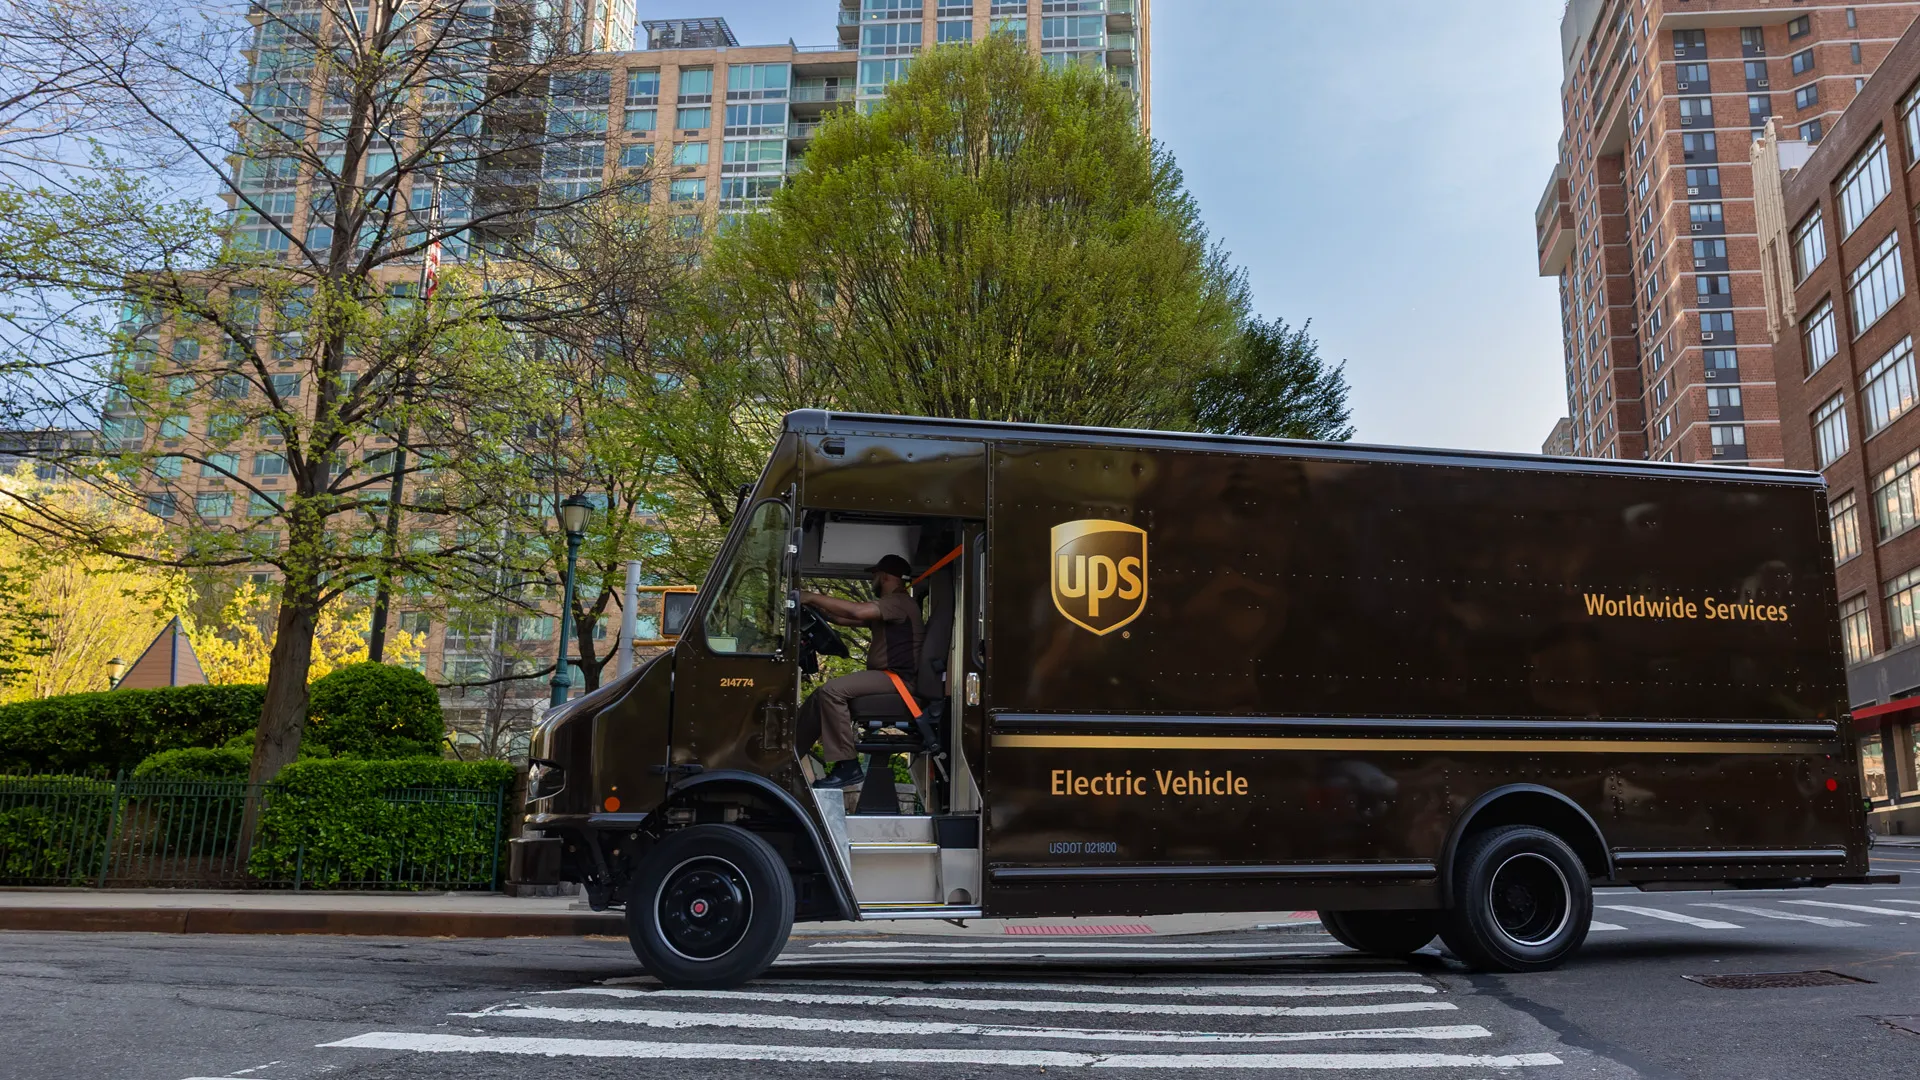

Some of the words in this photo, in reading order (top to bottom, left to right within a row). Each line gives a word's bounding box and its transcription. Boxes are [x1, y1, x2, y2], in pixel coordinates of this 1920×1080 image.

[1058, 554, 1142, 617] ups
[1583, 593, 1698, 619] Worldwide
[1704, 597, 1788, 622] Services
[720, 677, 755, 688] 214774
[1051, 769, 1147, 796] Electric
[1155, 770, 1249, 796] Vehicle
[1050, 842, 1083, 854] USDOT
[1085, 842, 1117, 854] 021800
